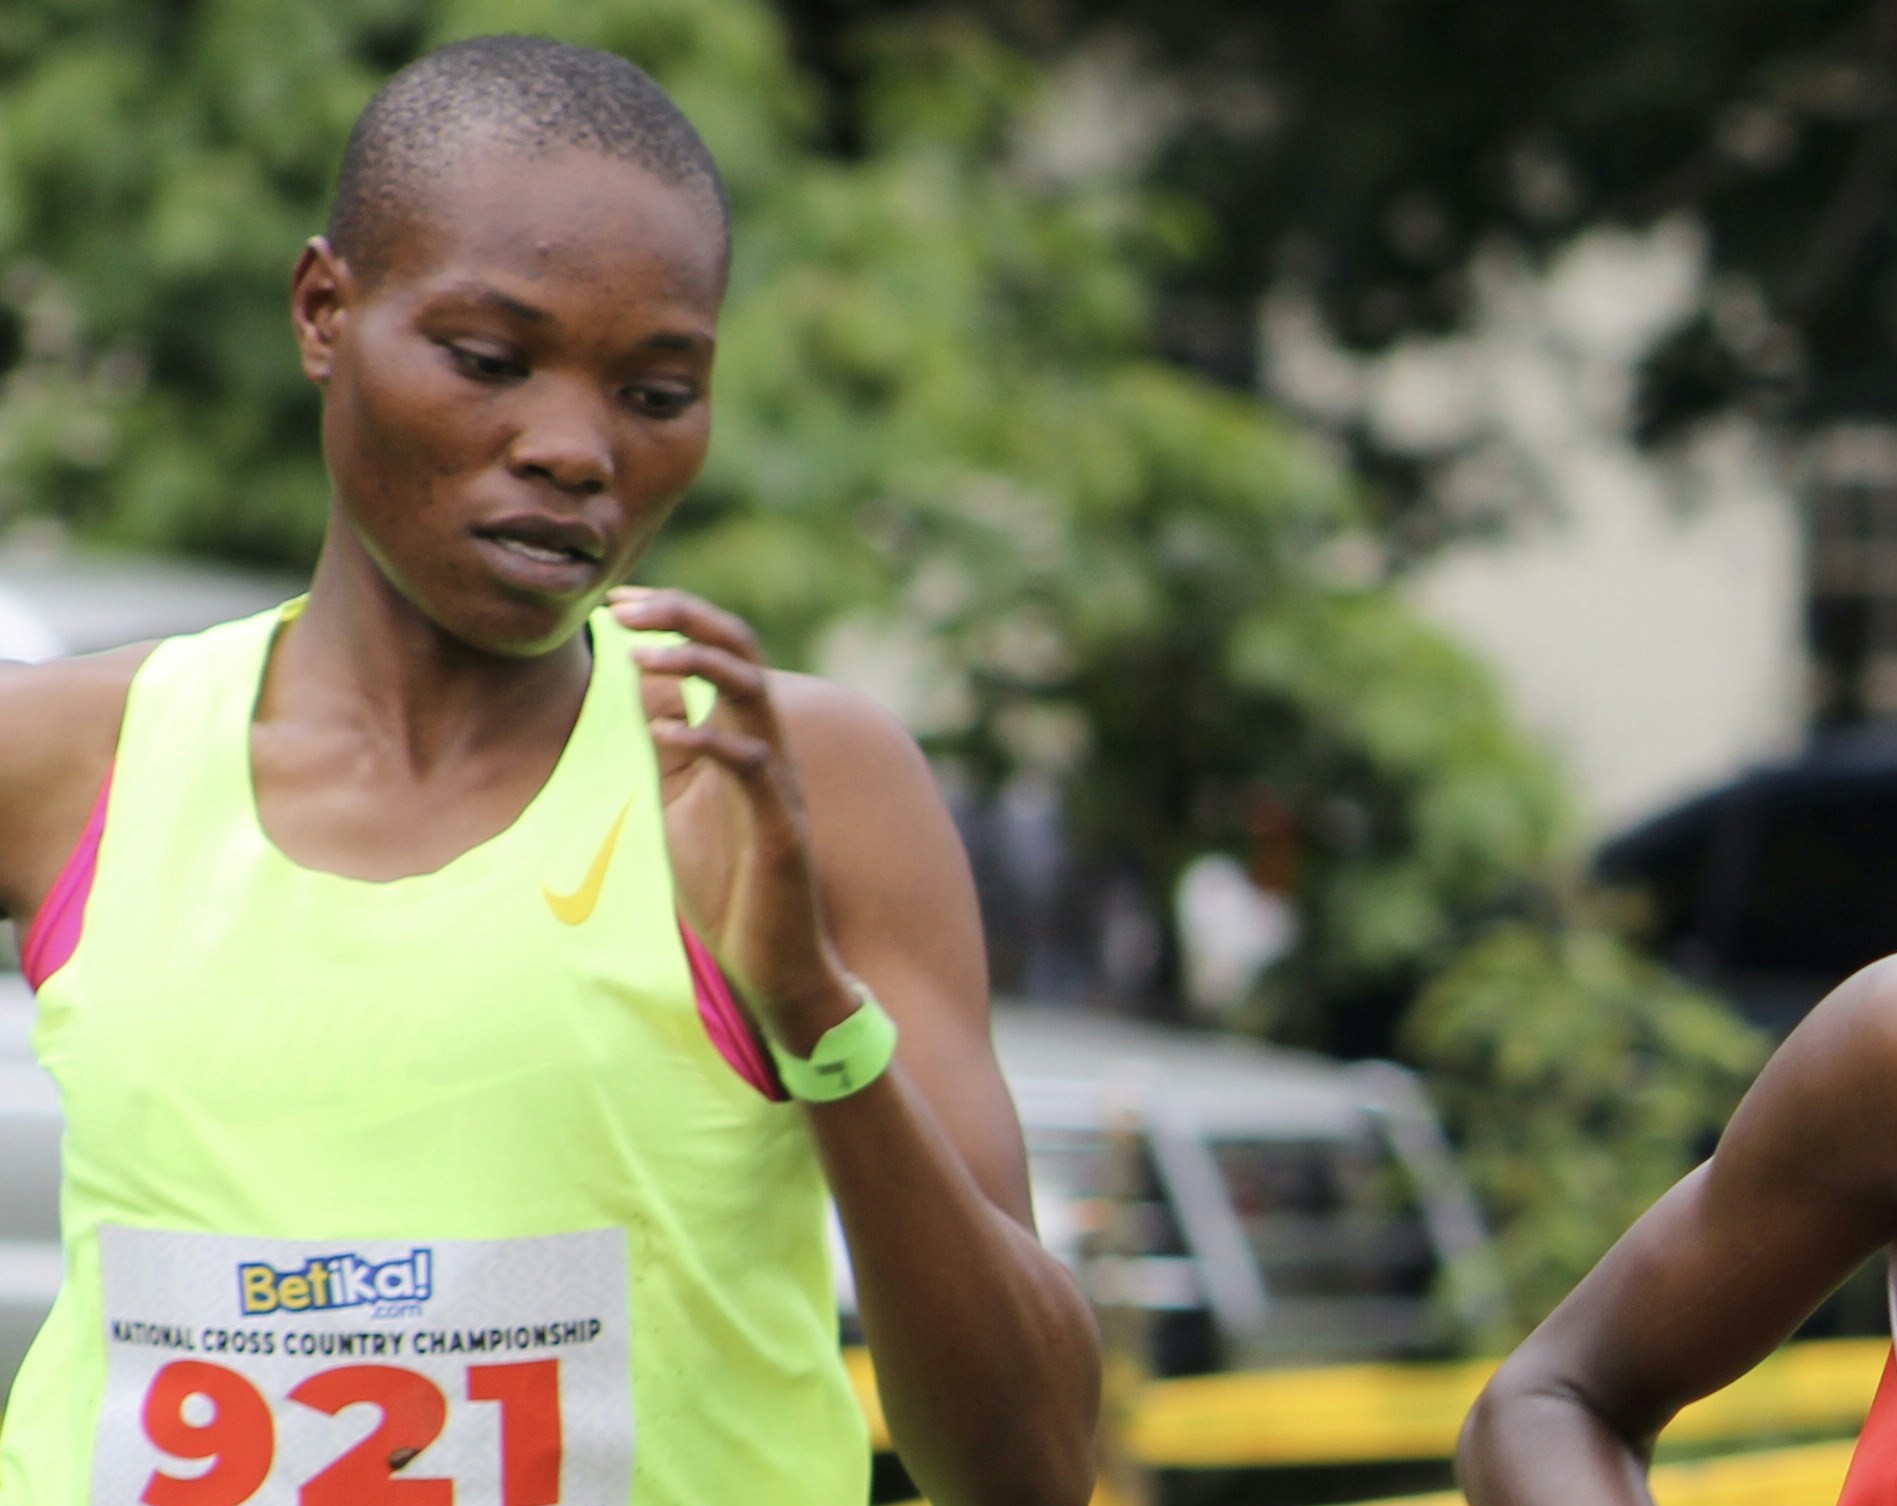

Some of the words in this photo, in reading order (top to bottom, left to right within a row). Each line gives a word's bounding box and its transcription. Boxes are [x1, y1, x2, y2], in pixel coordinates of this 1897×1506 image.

[239, 1248, 431, 1316] Betika!
[111, 1319, 195, 1352] NATIONAL
[202, 1328, 276, 1355] CROSS
[283, 1331, 402, 1356] COUNTRY
[413, 1318, 602, 1355] CHAMPIONSHIP
